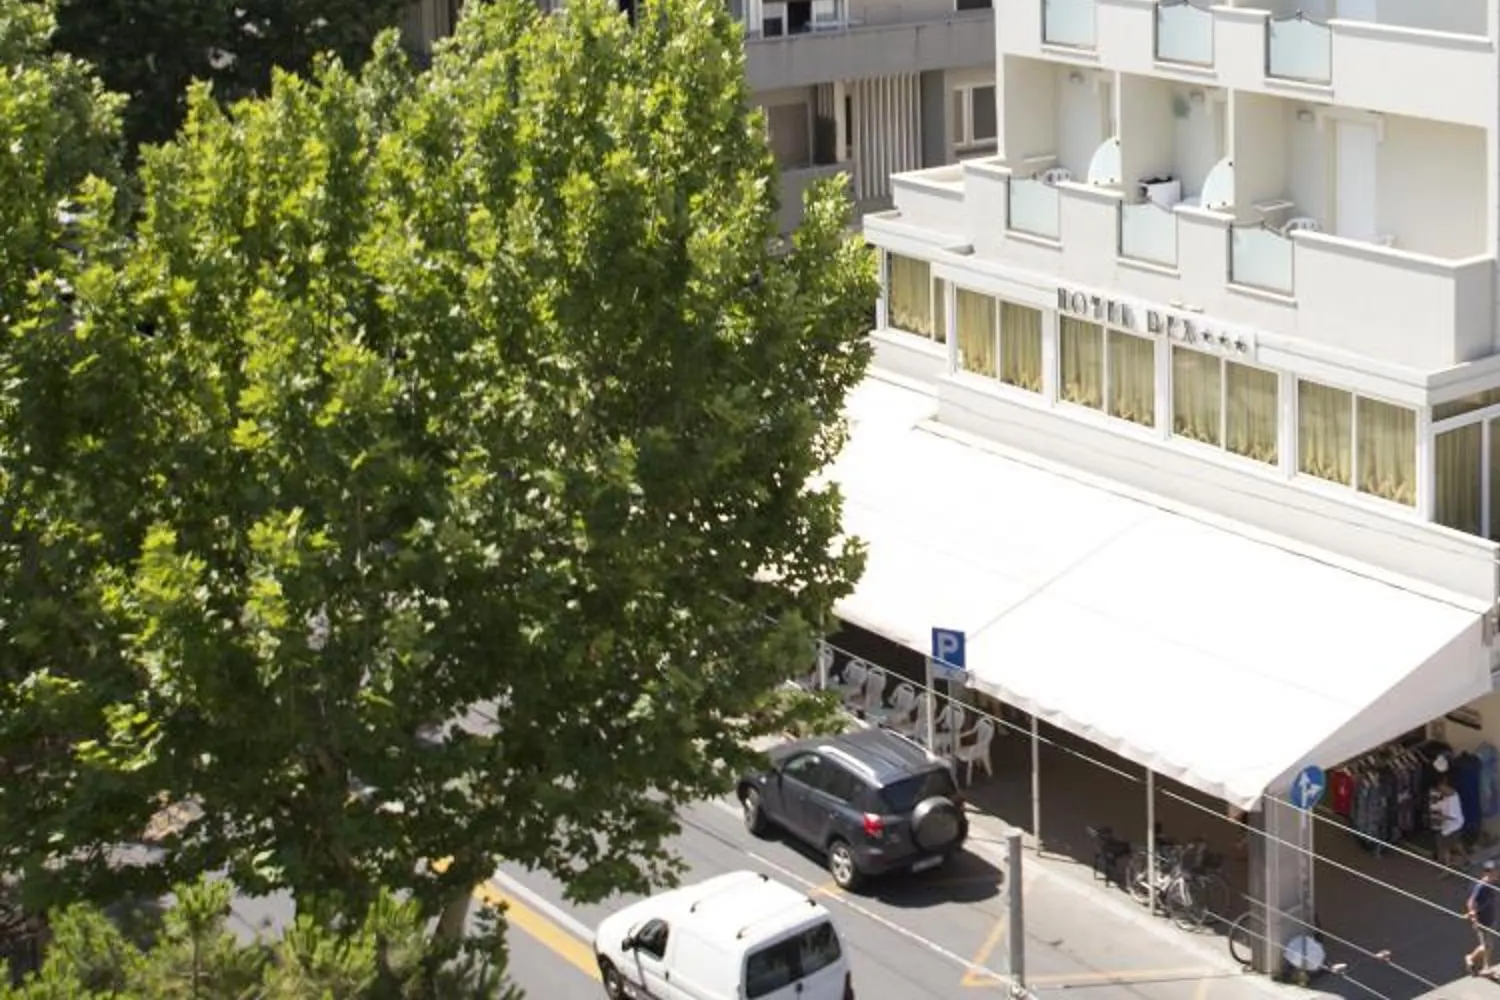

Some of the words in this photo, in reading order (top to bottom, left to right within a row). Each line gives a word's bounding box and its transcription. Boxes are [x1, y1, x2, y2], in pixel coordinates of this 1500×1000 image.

[1057, 287, 1134, 329] HOTEL
[1146, 310, 1197, 344] REX
[937, 631, 959, 661] P
